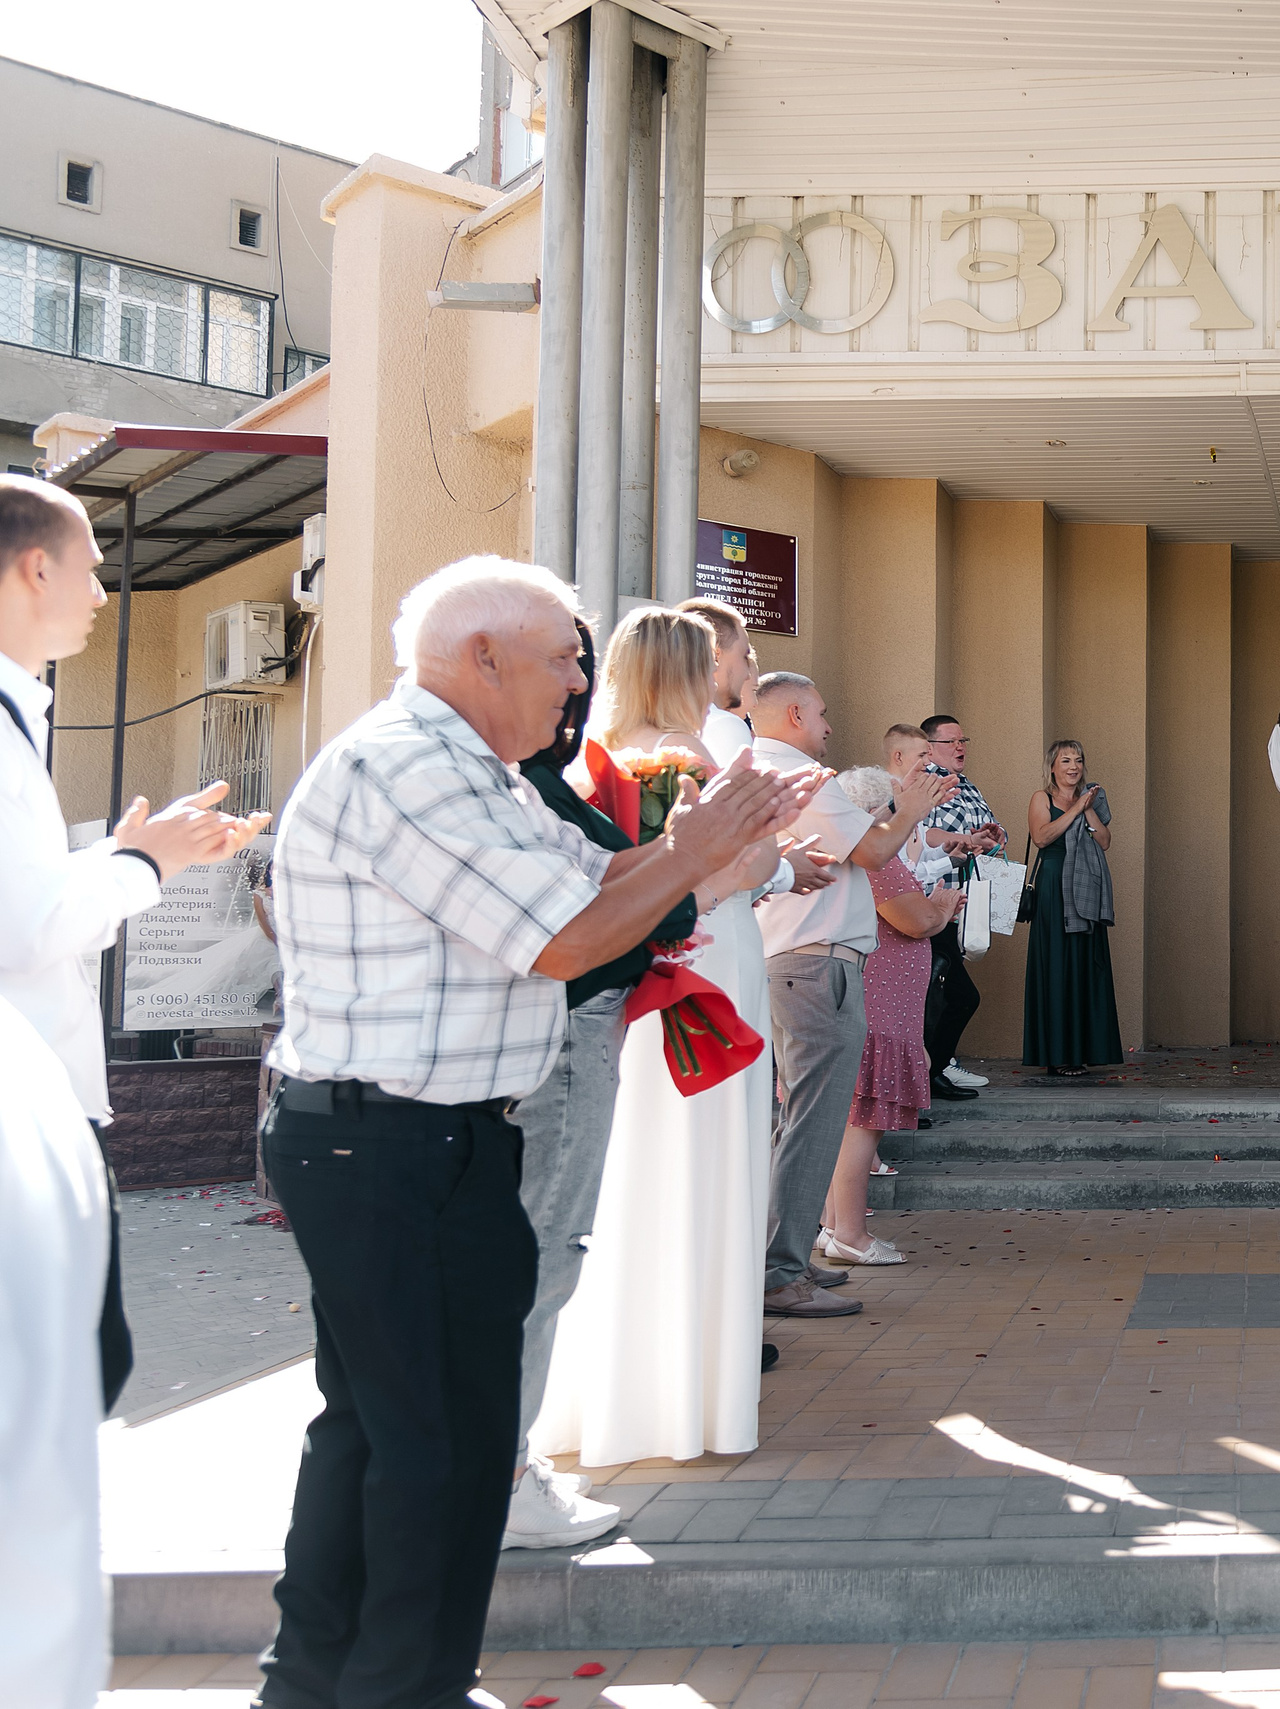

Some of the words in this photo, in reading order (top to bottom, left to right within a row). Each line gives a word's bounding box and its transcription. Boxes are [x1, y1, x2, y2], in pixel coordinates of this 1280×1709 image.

[745, 571, 783, 582] городского
[721, 576, 742, 585] город
[742, 578, 778, 590] Волжский
[696, 580, 747, 594] олгоградской
[748, 589, 776, 599] области
[732, 596, 765, 608] ЗАПИСИ
[733, 605, 782, 619] ДАНСКОГО
[160, 885, 209, 896] адебная
[153, 901, 217, 911] жутерия:
[138, 912, 201, 924] Диадемы
[139, 927, 185, 939] Серьги
[139, 941, 178, 951] Колье
[138, 955, 202, 966] Подвязки
[136, 995, 145, 1006] 8
[150, 993, 189, 1006] (906)
[193, 994, 216, 1005] 451
[220, 993, 238, 1004] 80
[242, 993, 258, 1004] 61
